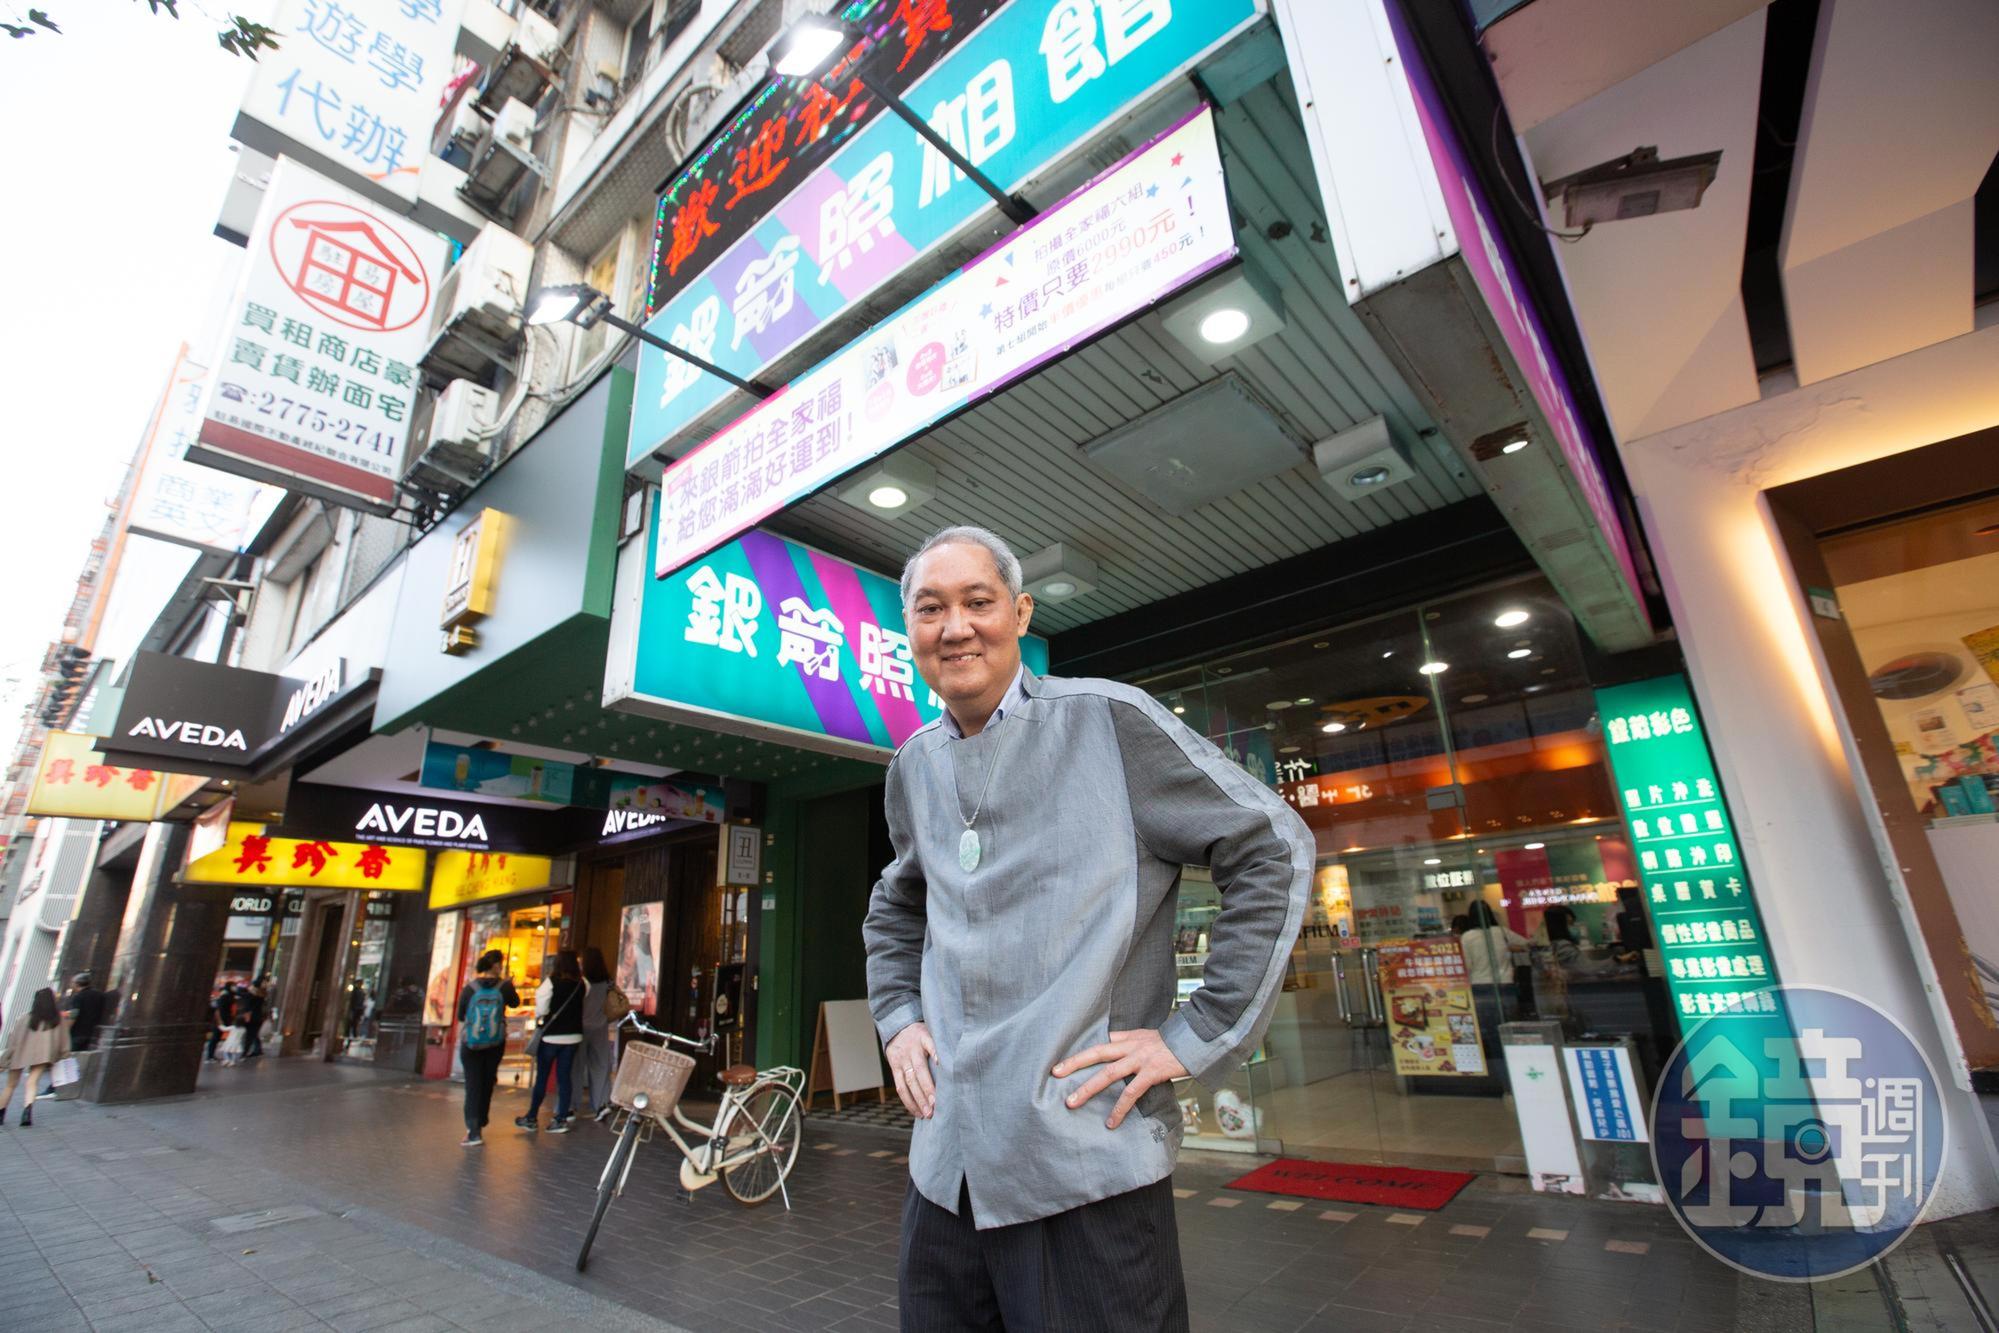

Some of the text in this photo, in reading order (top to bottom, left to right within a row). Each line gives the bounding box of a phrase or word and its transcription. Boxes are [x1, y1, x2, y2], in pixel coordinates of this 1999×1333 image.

[277, 68, 407, 176] 代辦
[280, 666, 342, 733] AVEDA
[129, 716, 248, 750] AVEDA
[355, 803, 488, 841] AVEDA
[1429, 942, 1461, 955] 2021
